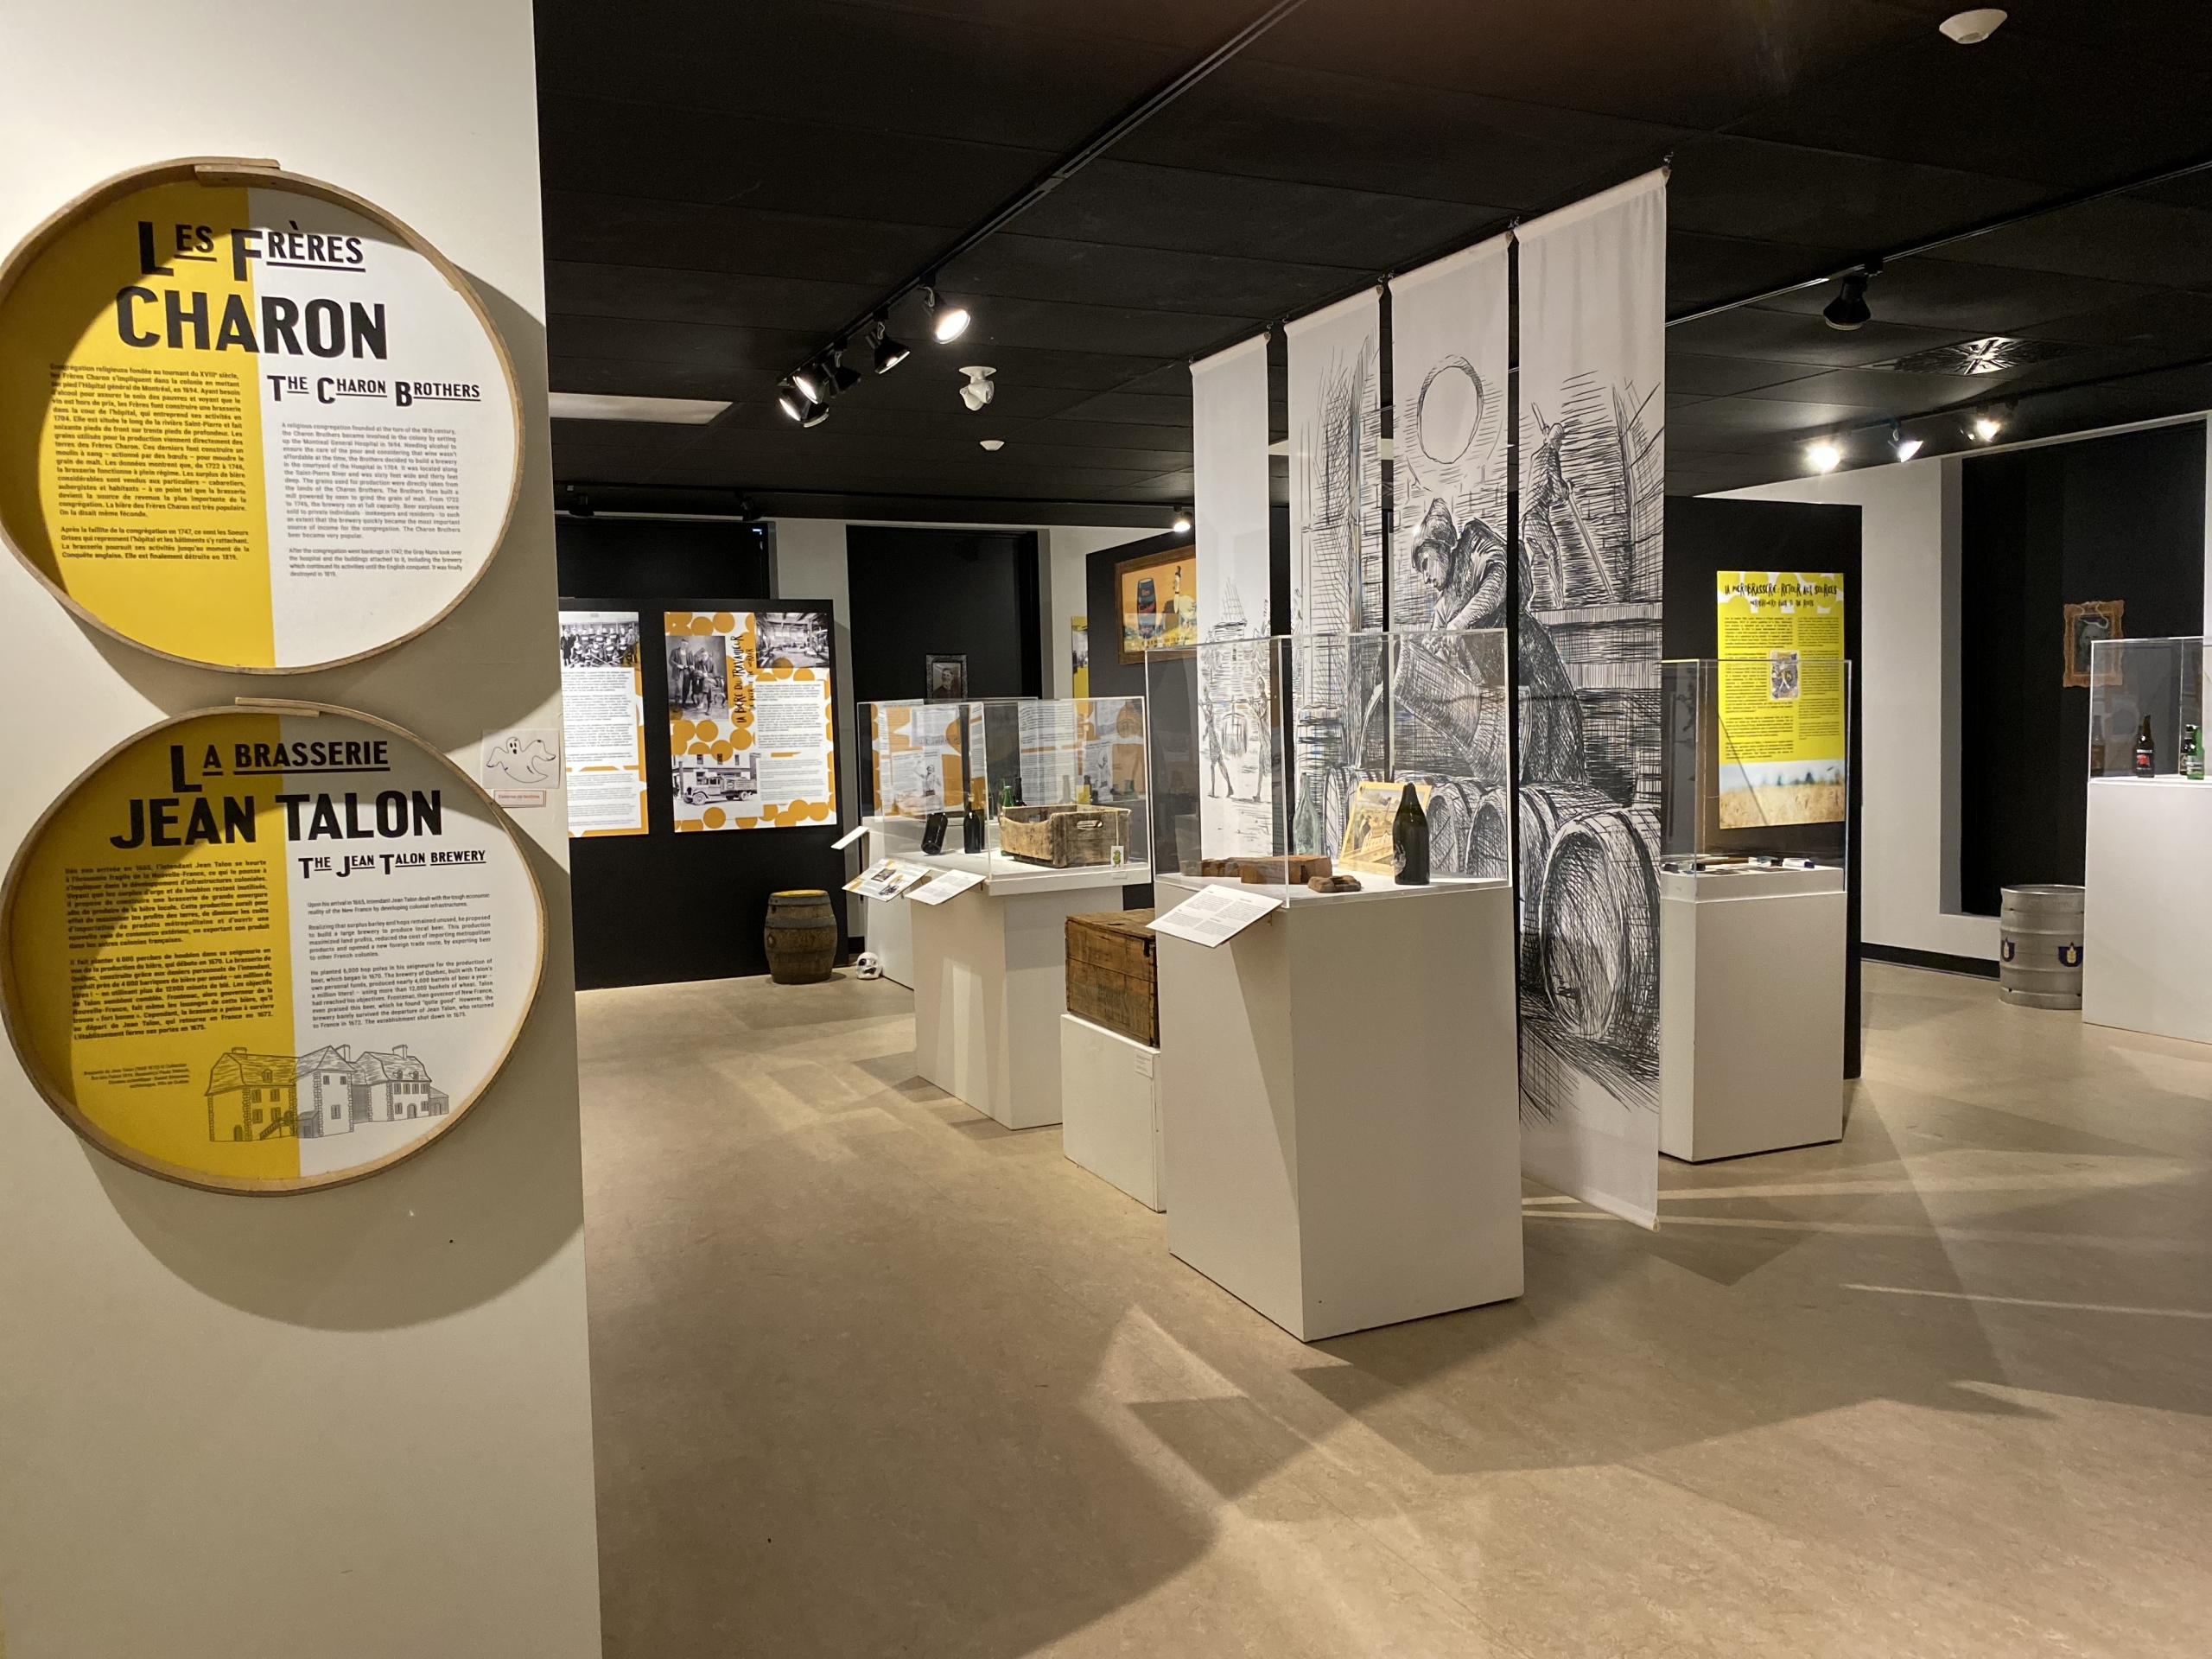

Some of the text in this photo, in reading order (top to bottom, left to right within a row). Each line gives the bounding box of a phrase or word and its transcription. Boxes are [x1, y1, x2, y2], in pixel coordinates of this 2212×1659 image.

[115, 284, 388, 360] CHARON
[734, 681, 743, 690] DU
[233, 741, 390, 772] BRASSERIE
[108, 790, 442, 849] JEAN TALON
[430, 850, 486, 866] BREWERY
[85, 1023, 107, 1032] départ
[376, 1015, 416, 1024] establishment
